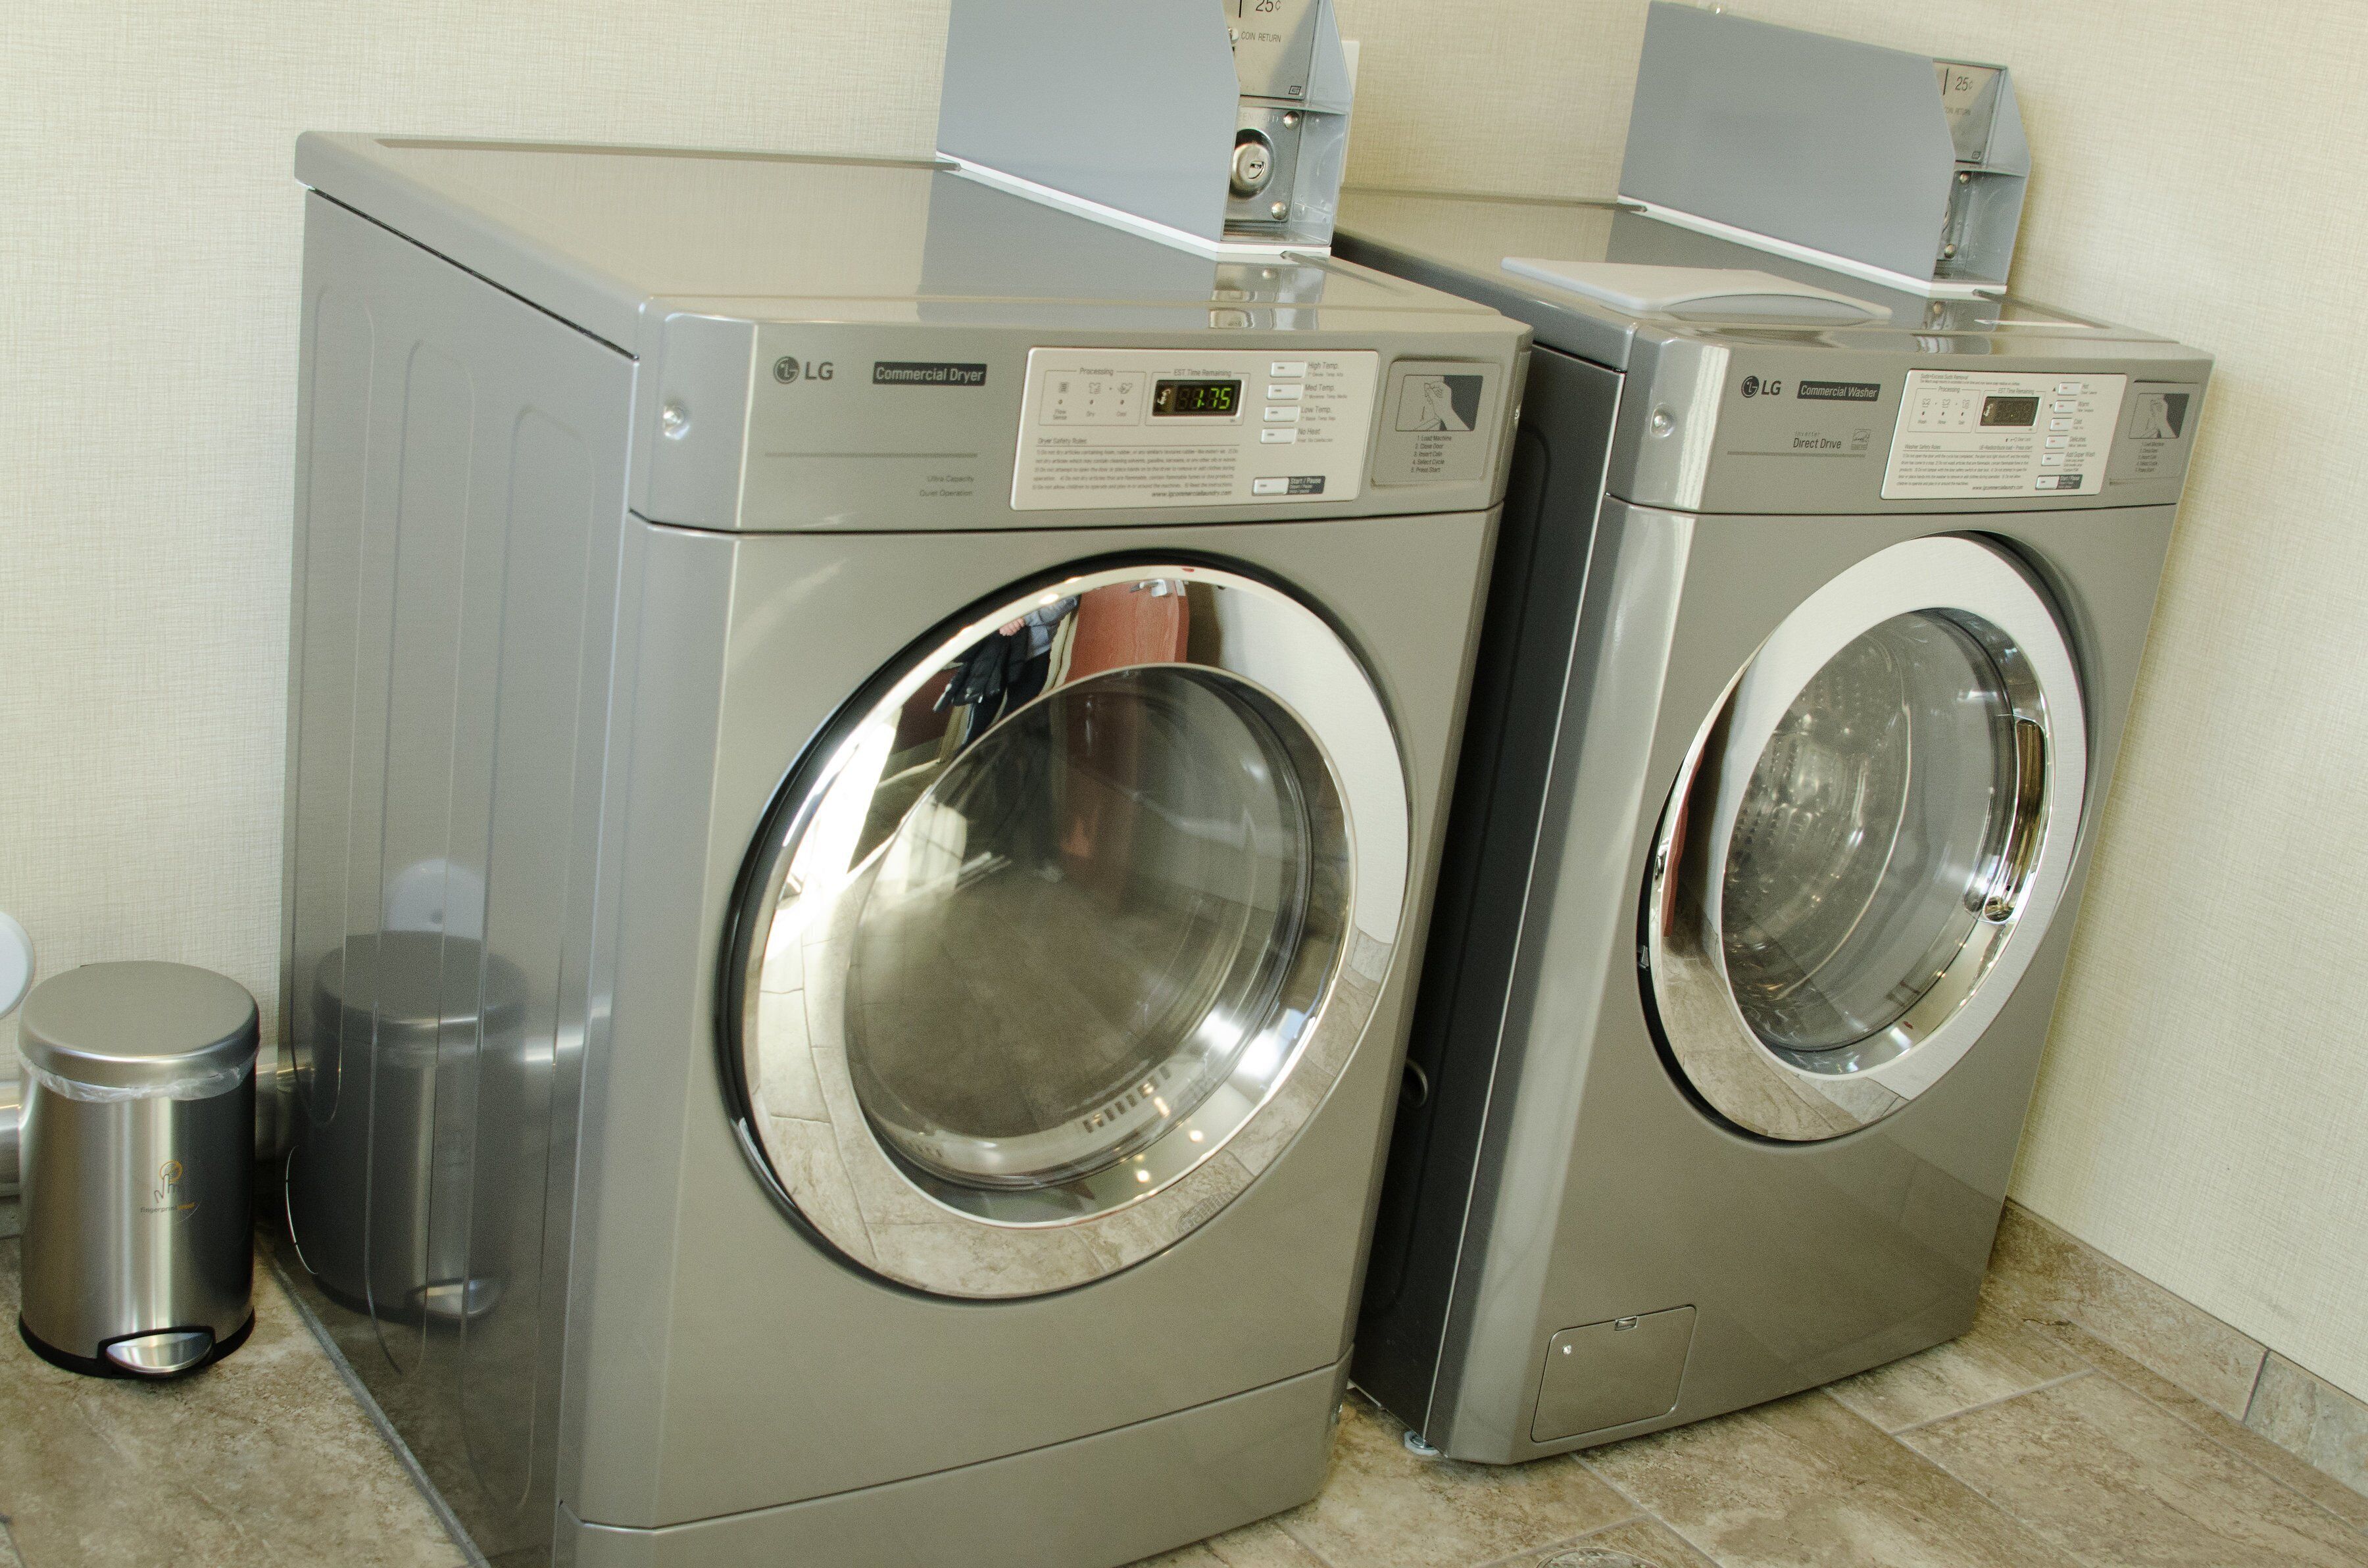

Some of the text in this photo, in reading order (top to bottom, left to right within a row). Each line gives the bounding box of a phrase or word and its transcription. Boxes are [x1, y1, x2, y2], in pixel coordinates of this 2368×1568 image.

[1255, 0, 1281, 12] 25¢
[1241, 32, 1281, 43] COIN RETURN
[1955, 76, 1973, 91] 25¢
[804, 361, 834, 380] LG
[1079, 368, 1114, 376] Processing
[1308, 362, 1321, 370] High
[876, 366, 983, 384] Commercial Dryer
[1762, 380, 1782, 395] LG
[1801, 385, 1877, 398] Commercial Washer
[1793, 437, 1842, 449] Direct Drive
